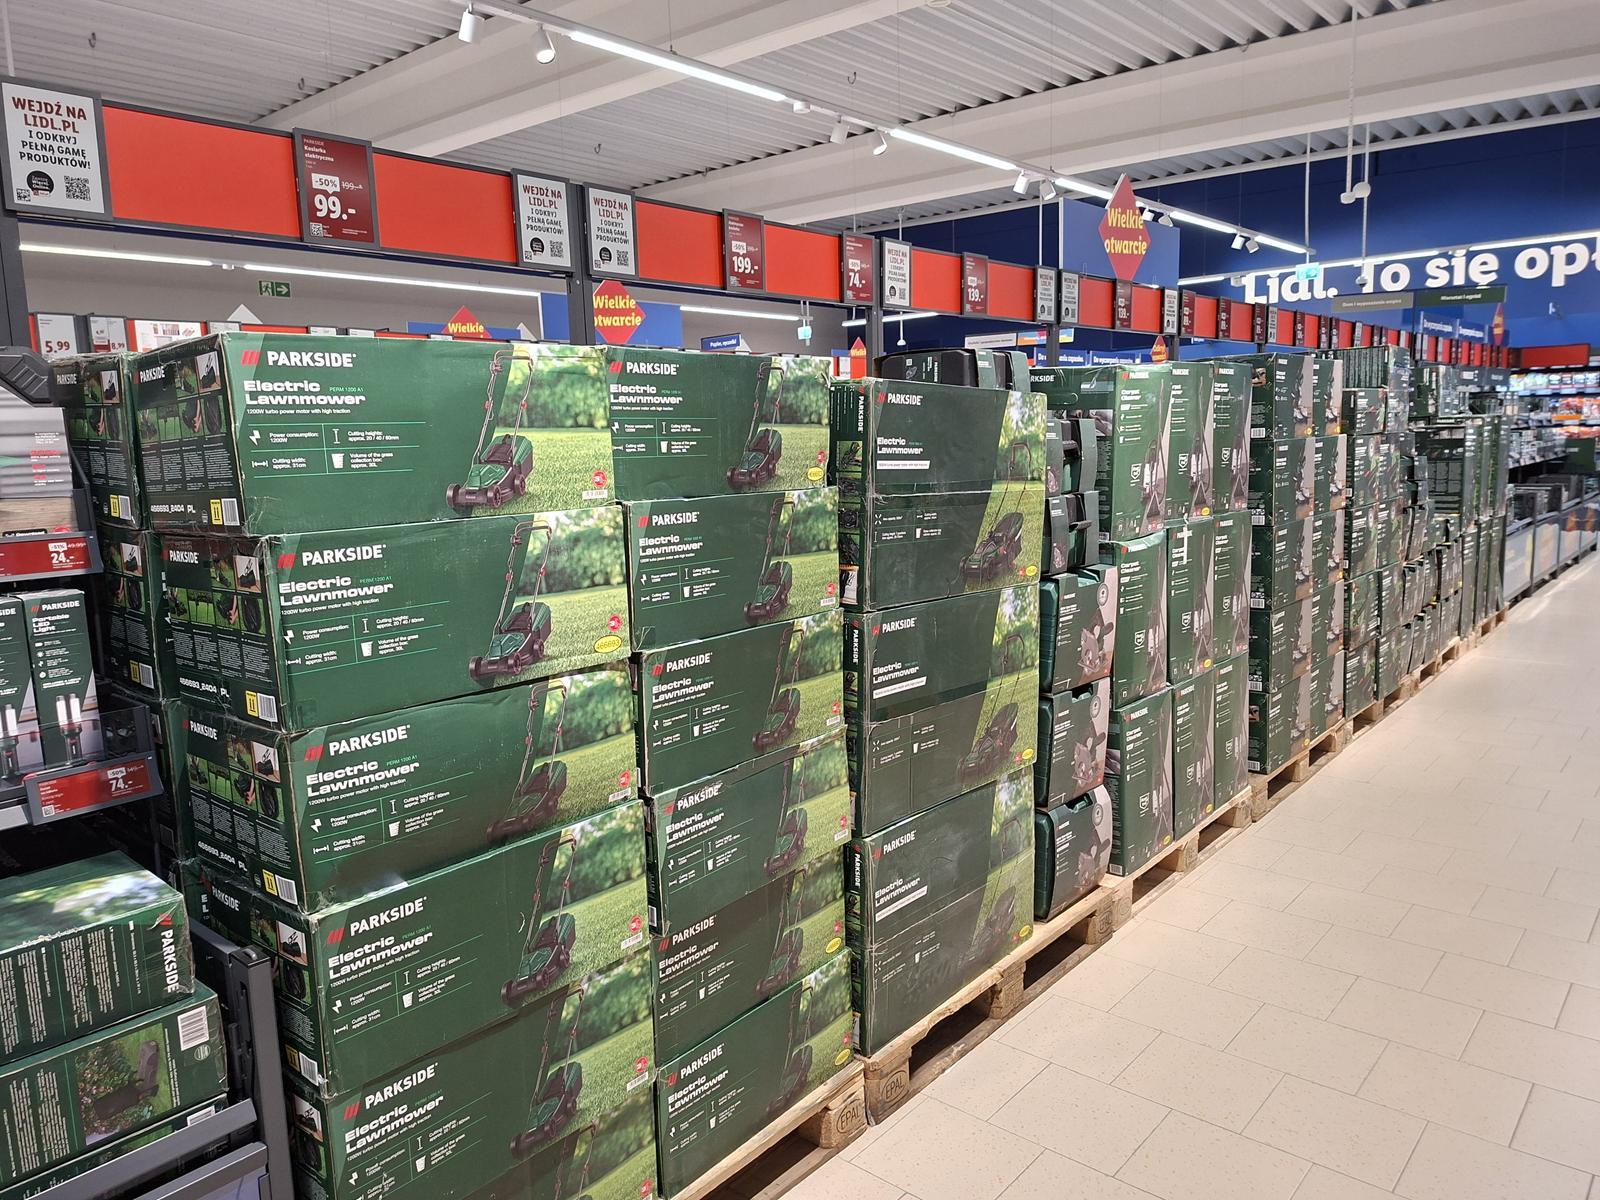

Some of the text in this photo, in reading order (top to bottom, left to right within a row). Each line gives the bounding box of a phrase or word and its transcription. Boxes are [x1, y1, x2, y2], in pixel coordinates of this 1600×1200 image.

[12, 96, 87, 120] WEJDŹ NA
[24, 113, 79, 134] LIDL.PL
[28, 130, 77, 145] I ODKRYJ
[21, 140, 86, 159] PEŁNĄ GAMĘ
[304, 145, 326, 154] Kosiarka
[304, 153, 334, 162] elektryczna
[19, 151, 91, 169] PRODUKTÓW!
[315, 177, 338, 188] -50%
[522, 184, 562, 199] WEJDŹ NA
[314, 194, 356, 220] 99.-
[528, 196, 558, 209] LIDL.PL
[618, 202, 628, 211] NA
[535, 209, 557, 217] ODKRYJ
[598, 209, 624, 220] LIDL.PL
[1107, 207, 1144, 230] Wielkie
[1104, 235, 1147, 255] otwarcie
[732, 256, 759, 274] 199.-
[1425, 250, 1500, 290] się
[848, 272, 866, 288] 74.-
[593, 294, 636, 309] Wielkie
[448, 322, 484, 334] Wielkie
[45, 340, 70, 353] 5.99
[266, 351, 354, 368] PARKSIDE
[626, 361, 678, 376] PARKSIDE
[139, 367, 165, 383] PARKSIDE
[243, 380, 321, 392] Electric
[610, 384, 657, 394] Electric
[245, 394, 366, 405] Lawnmower
[610, 395, 683, 405] Lawnmower
[887, 392, 922, 406] PARKSIDE
[876, 437, 906, 446] Electric
[876, 446, 924, 455] Lawnmower
[187, 505, 196, 514] PL
[651, 511, 698, 527] PARKSIDE
[638, 534, 680, 547] Electric
[639, 541, 704, 556] Lawnmower
[50, 552, 75, 564] 24.-
[169, 550, 199, 565] PARKSIDE
[302, 544, 384, 567] PARKSIDE
[279, 575, 352, 594] Electric
[280, 583, 394, 606] Lawnmower
[42, 600, 80, 612] PARKSIDE
[32, 613, 70, 622] Portable
[882, 619, 916, 634] PARKSIDE
[33, 625, 56, 633] Light
[666, 652, 711, 673] PARKSIDE
[872, 661, 902, 676] Electric
[873, 666, 920, 684] Lawnmower
[220, 687, 230, 697] PL
[652, 677, 692, 694] Electric
[652, 681, 714, 703] Lawnmower
[190, 720, 218, 741] PARKSIDE
[329, 725, 408, 756] PARKSIDE
[306, 760, 379, 785] Electric
[307, 762, 420, 798] Lawnmower
[109, 779, 133, 792] 74.-
[677, 785, 720, 811] PARKSIDE
[665, 811, 703, 834] Electric
[666, 812, 725, 843] Lawnmower
[883, 831, 916, 855] PARKSIDE
[875, 878, 904, 899] Electric
[875, 878, 920, 908] Lawnmower
[350, 897, 425, 937] PARKSIDE
[672, 915, 715, 946] PARKSIDE
[161, 929, 180, 993] PARKSIDE
[328, 936, 395, 968] Electric
[329, 932, 433, 980] Lawnmower
[658, 944, 698, 969] Electric
[659, 941, 720, 978] Lawnmower
[680, 1045, 724, 1080] PARKSIDE
[364, 1063, 437, 1110] PARKSIDE
[667, 1074, 707, 1103] Electric
[668, 1070, 729, 1113] Lawnmower
[885, 1075, 904, 1099] EPAL
[345, 1103, 409, 1143] Electric
[346, 1096, 444, 1154] Lawnmower
[840, 1104, 860, 1131] EPAL
